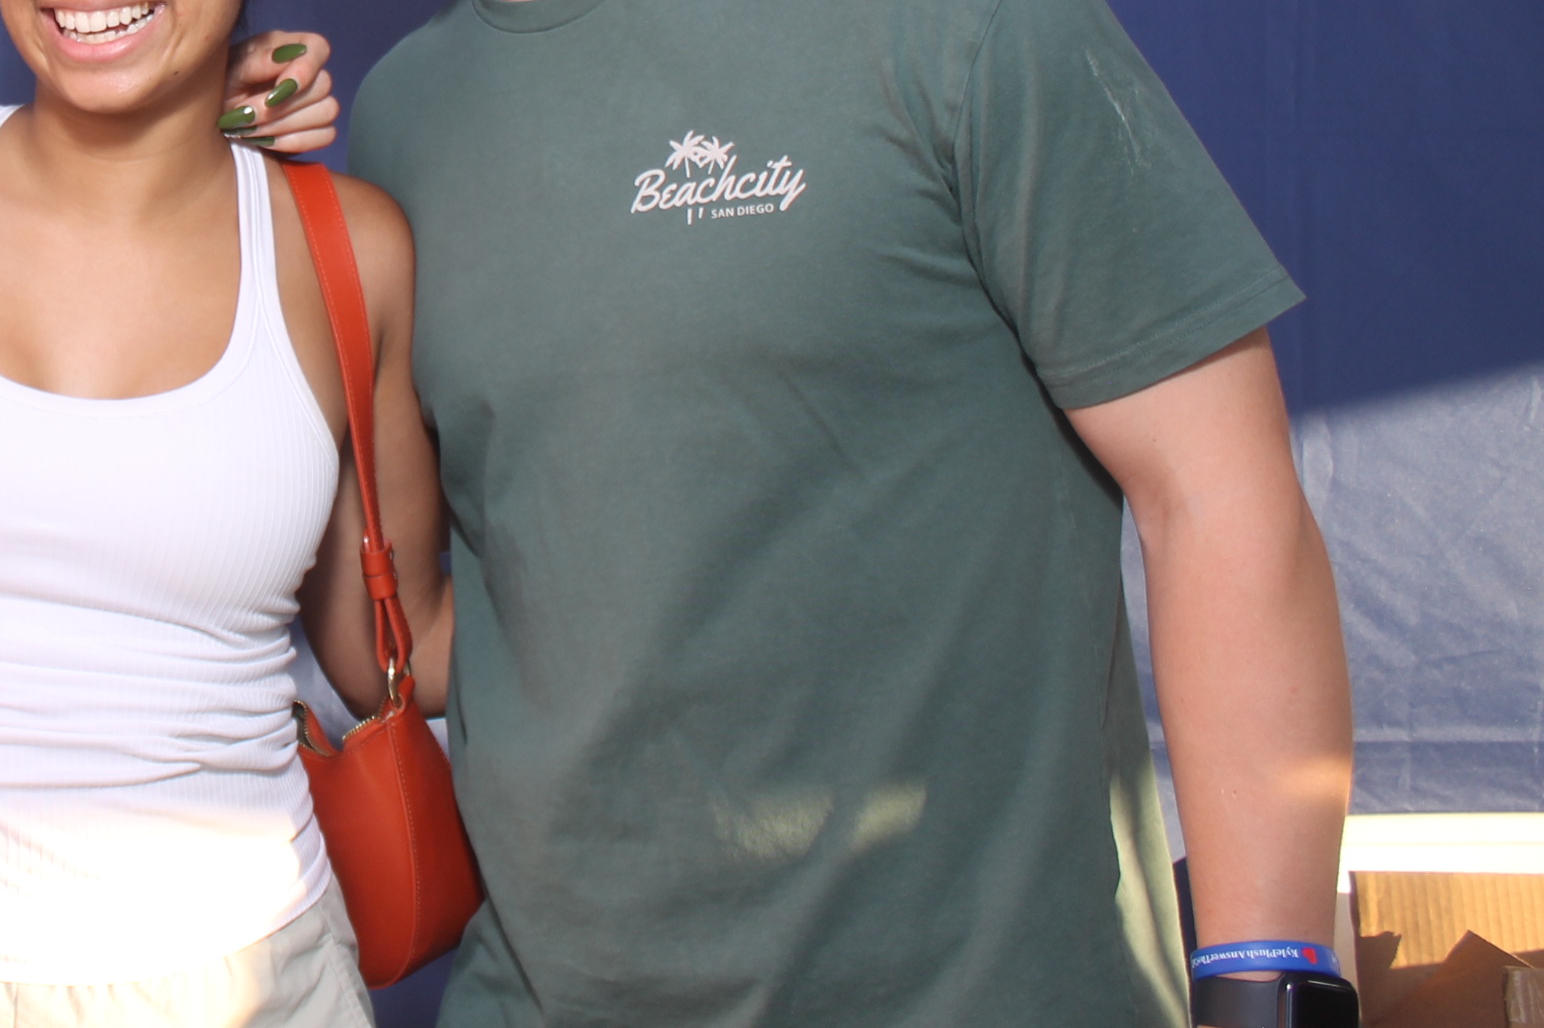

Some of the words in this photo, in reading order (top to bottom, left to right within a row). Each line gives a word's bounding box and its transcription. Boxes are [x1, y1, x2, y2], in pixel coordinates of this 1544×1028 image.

[630, 154, 807, 214] Beachcity
[711, 207, 735, 219] SAN
[736, 203, 774, 217] DIEGO
